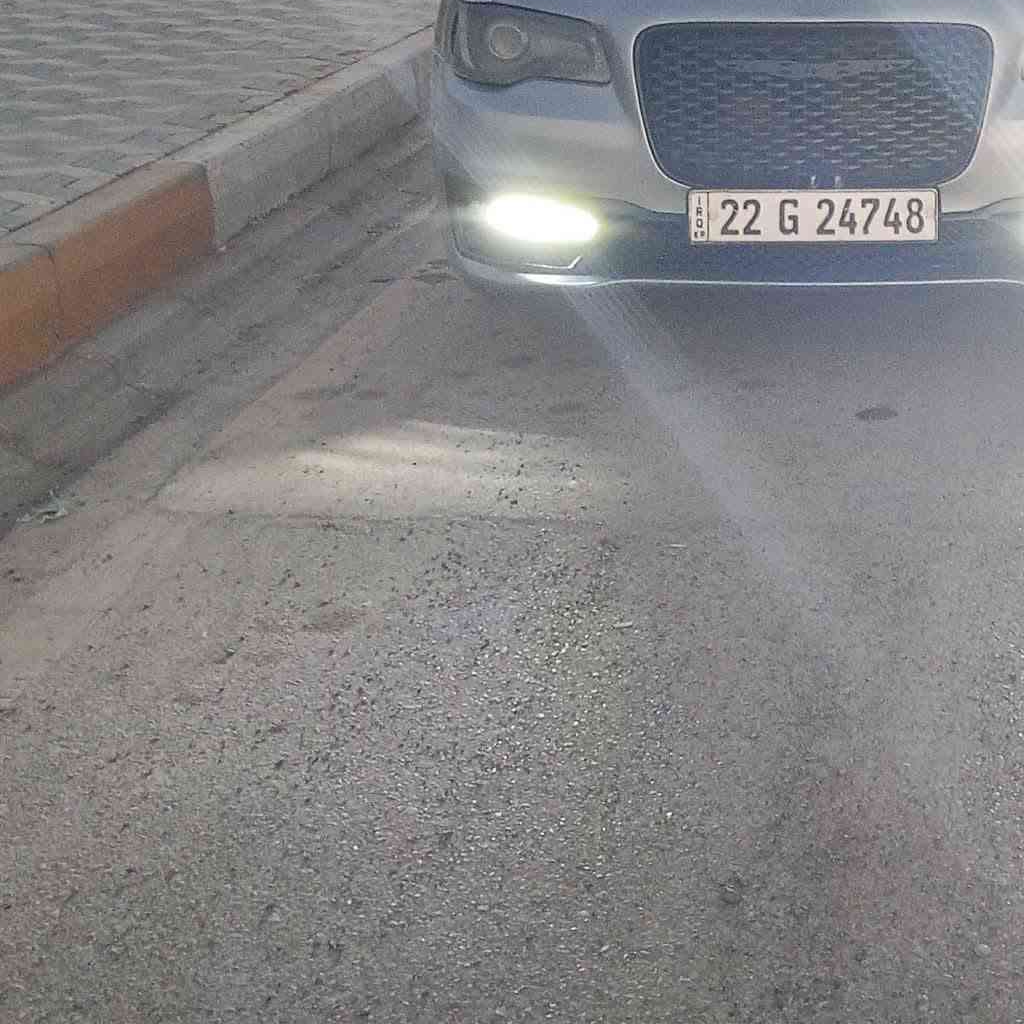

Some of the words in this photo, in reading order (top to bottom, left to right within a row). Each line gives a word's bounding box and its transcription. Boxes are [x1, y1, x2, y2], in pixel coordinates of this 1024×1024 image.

[696, 194, 704, 229] IRQ
[720, 198, 762, 236] 22
[778, 198, 799, 236] G
[815, 198, 925, 236] 24748
